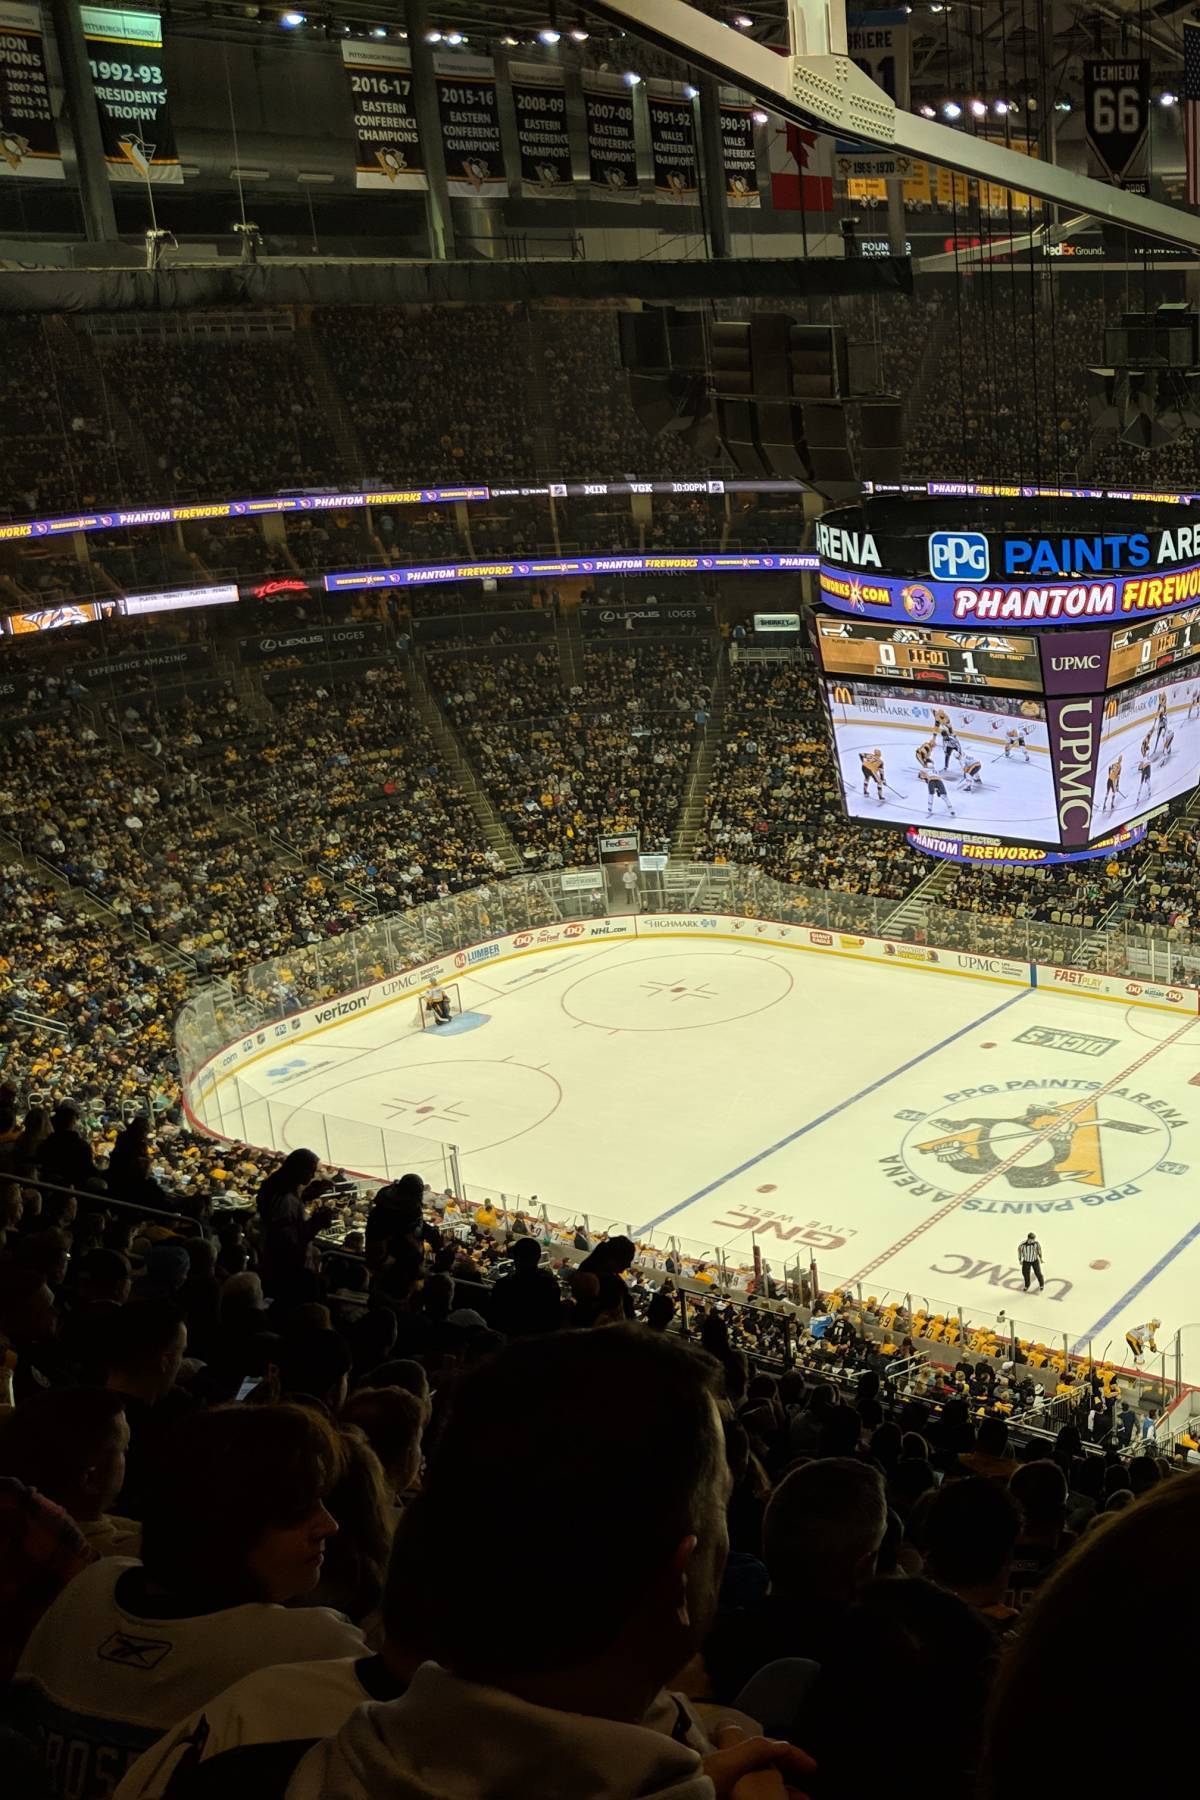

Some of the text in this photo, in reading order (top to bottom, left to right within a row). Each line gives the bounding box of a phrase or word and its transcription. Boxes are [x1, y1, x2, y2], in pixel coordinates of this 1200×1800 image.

[89, 60, 163, 84] 1992-93
[1093, 64, 1140, 82] LEMIEUX
[352, 76, 411, 96] 2016-17
[441, 88, 494, 105] 2015-16
[517, 95, 564, 113] 2008-09
[105, 104, 158, 121] TROPHY
[362, 101, 407, 115] EASTERN
[588, 103, 633, 121] 2007-08
[1093, 87, 1140, 134] 66
[450, 112, 492, 124] EASTERN
[524, 119, 561, 131] EASTERN
[652, 109, 692, 127] 1991-92
[358, 129, 419, 144] CHAMPIONS
[594, 124, 629, 137] EASTERN
[660, 130, 684, 142] WALES
[724, 136, 746, 147] WALES
[584, 482, 707, 495] MIN VGK 10:00PM
[932, 483, 1021, 497] PHANTOM FIREWORKS
[314, 491, 423, 507] PHANTOM FIREWORKS
[119, 506, 231, 525] PHANTOM FIREWORKS
[933, 537, 986, 575] PPG
[1004, 533, 1150, 574] PAINTS
[407, 565, 515, 581] PHANTOM FIREWORKS
[595, 559, 699, 569] PHANTOM FIREWORKS
[954, 584, 1115, 618] PHANTOM
[667, 609, 697, 619] LOGES
[333, 630, 365, 642] LOGES
[1183, 626, 1192, 649] 1
[144, 653, 188, 666] AMAZING
[878, 643, 897, 666] 0
[911, 649, 945, 665] 11:01
[1141, 640, 1152, 663] 0
[961, 651, 979, 675] 1
[1050, 655, 1102, 673] UPMC
[1059, 700, 1094, 831] UPMC
[606, 838, 631, 849] FedEx
[912, 833, 1047, 861] PHANTOM FIREWORKS
[567, 926, 583, 936] DQ
[650, 920, 700, 929] HIGHMARK
[516, 935, 531, 946] DQ
[467, 944, 501, 962] LUMBER
[957, 955, 1000, 973] UPMC
[1053, 969, 1082, 983] FAST
[382, 976, 417, 997] UPMC
[1128, 986, 1141, 994] DQ
[1167, 992, 1182, 1000] DQ
[314, 995, 367, 1025] verizon
[943, 1078, 1190, 1130] PPG PAINTS ARENA
[878, 1153, 1144, 1215] PPG PAINTS ARENA
[737, 1203, 859, 1238] LIVE WELL
[712, 1209, 848, 1251] GNC
[928, 1253, 1075, 1302] UPMC
